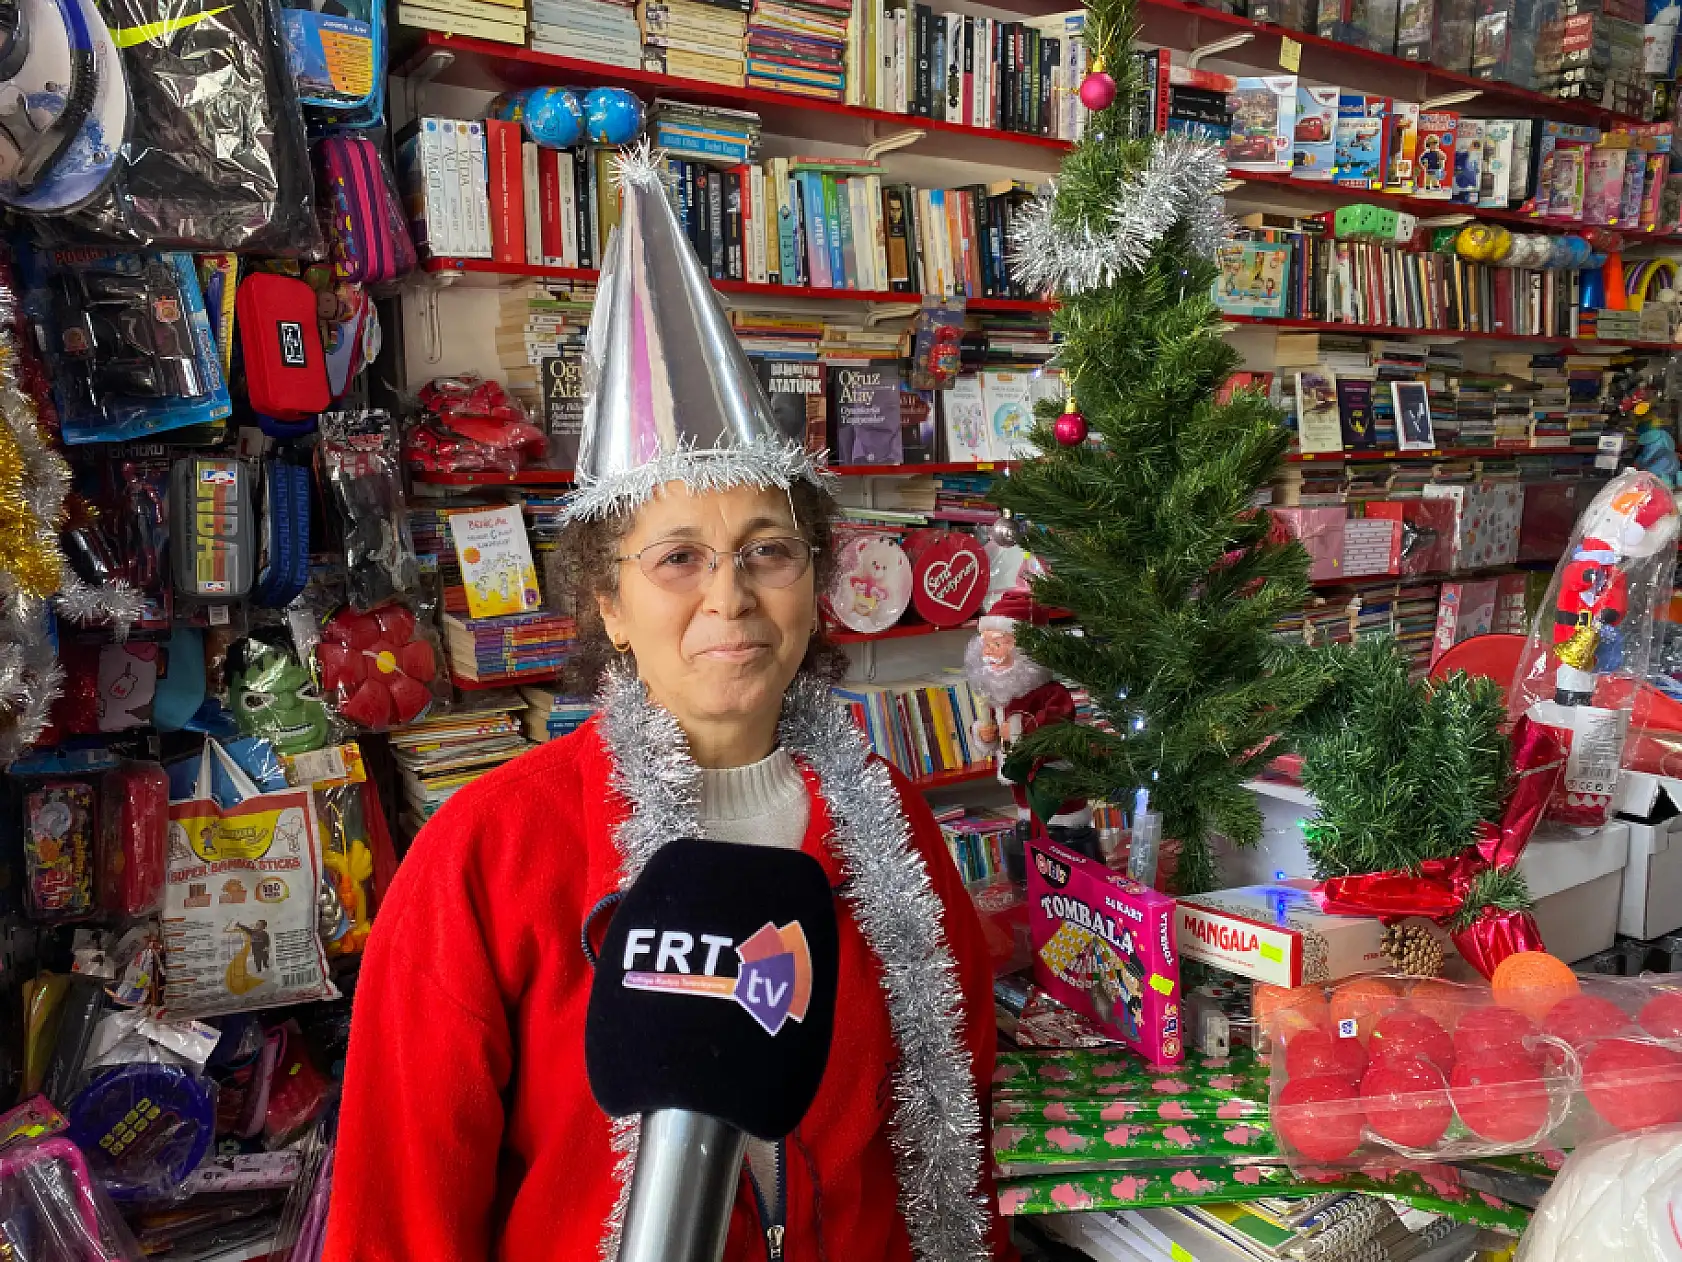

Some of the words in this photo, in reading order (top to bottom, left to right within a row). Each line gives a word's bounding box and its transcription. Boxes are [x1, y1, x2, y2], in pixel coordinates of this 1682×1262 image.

[768, 378, 822, 395] ATATÜRK
[838, 369, 881, 389] Oğuz
[838, 389, 875, 406] Atay
[1041, 894, 1135, 956] TOMBALA
[1184, 913, 1261, 952] MANGALA
[622, 928, 733, 977] FRT
[746, 968, 788, 1008] tv
